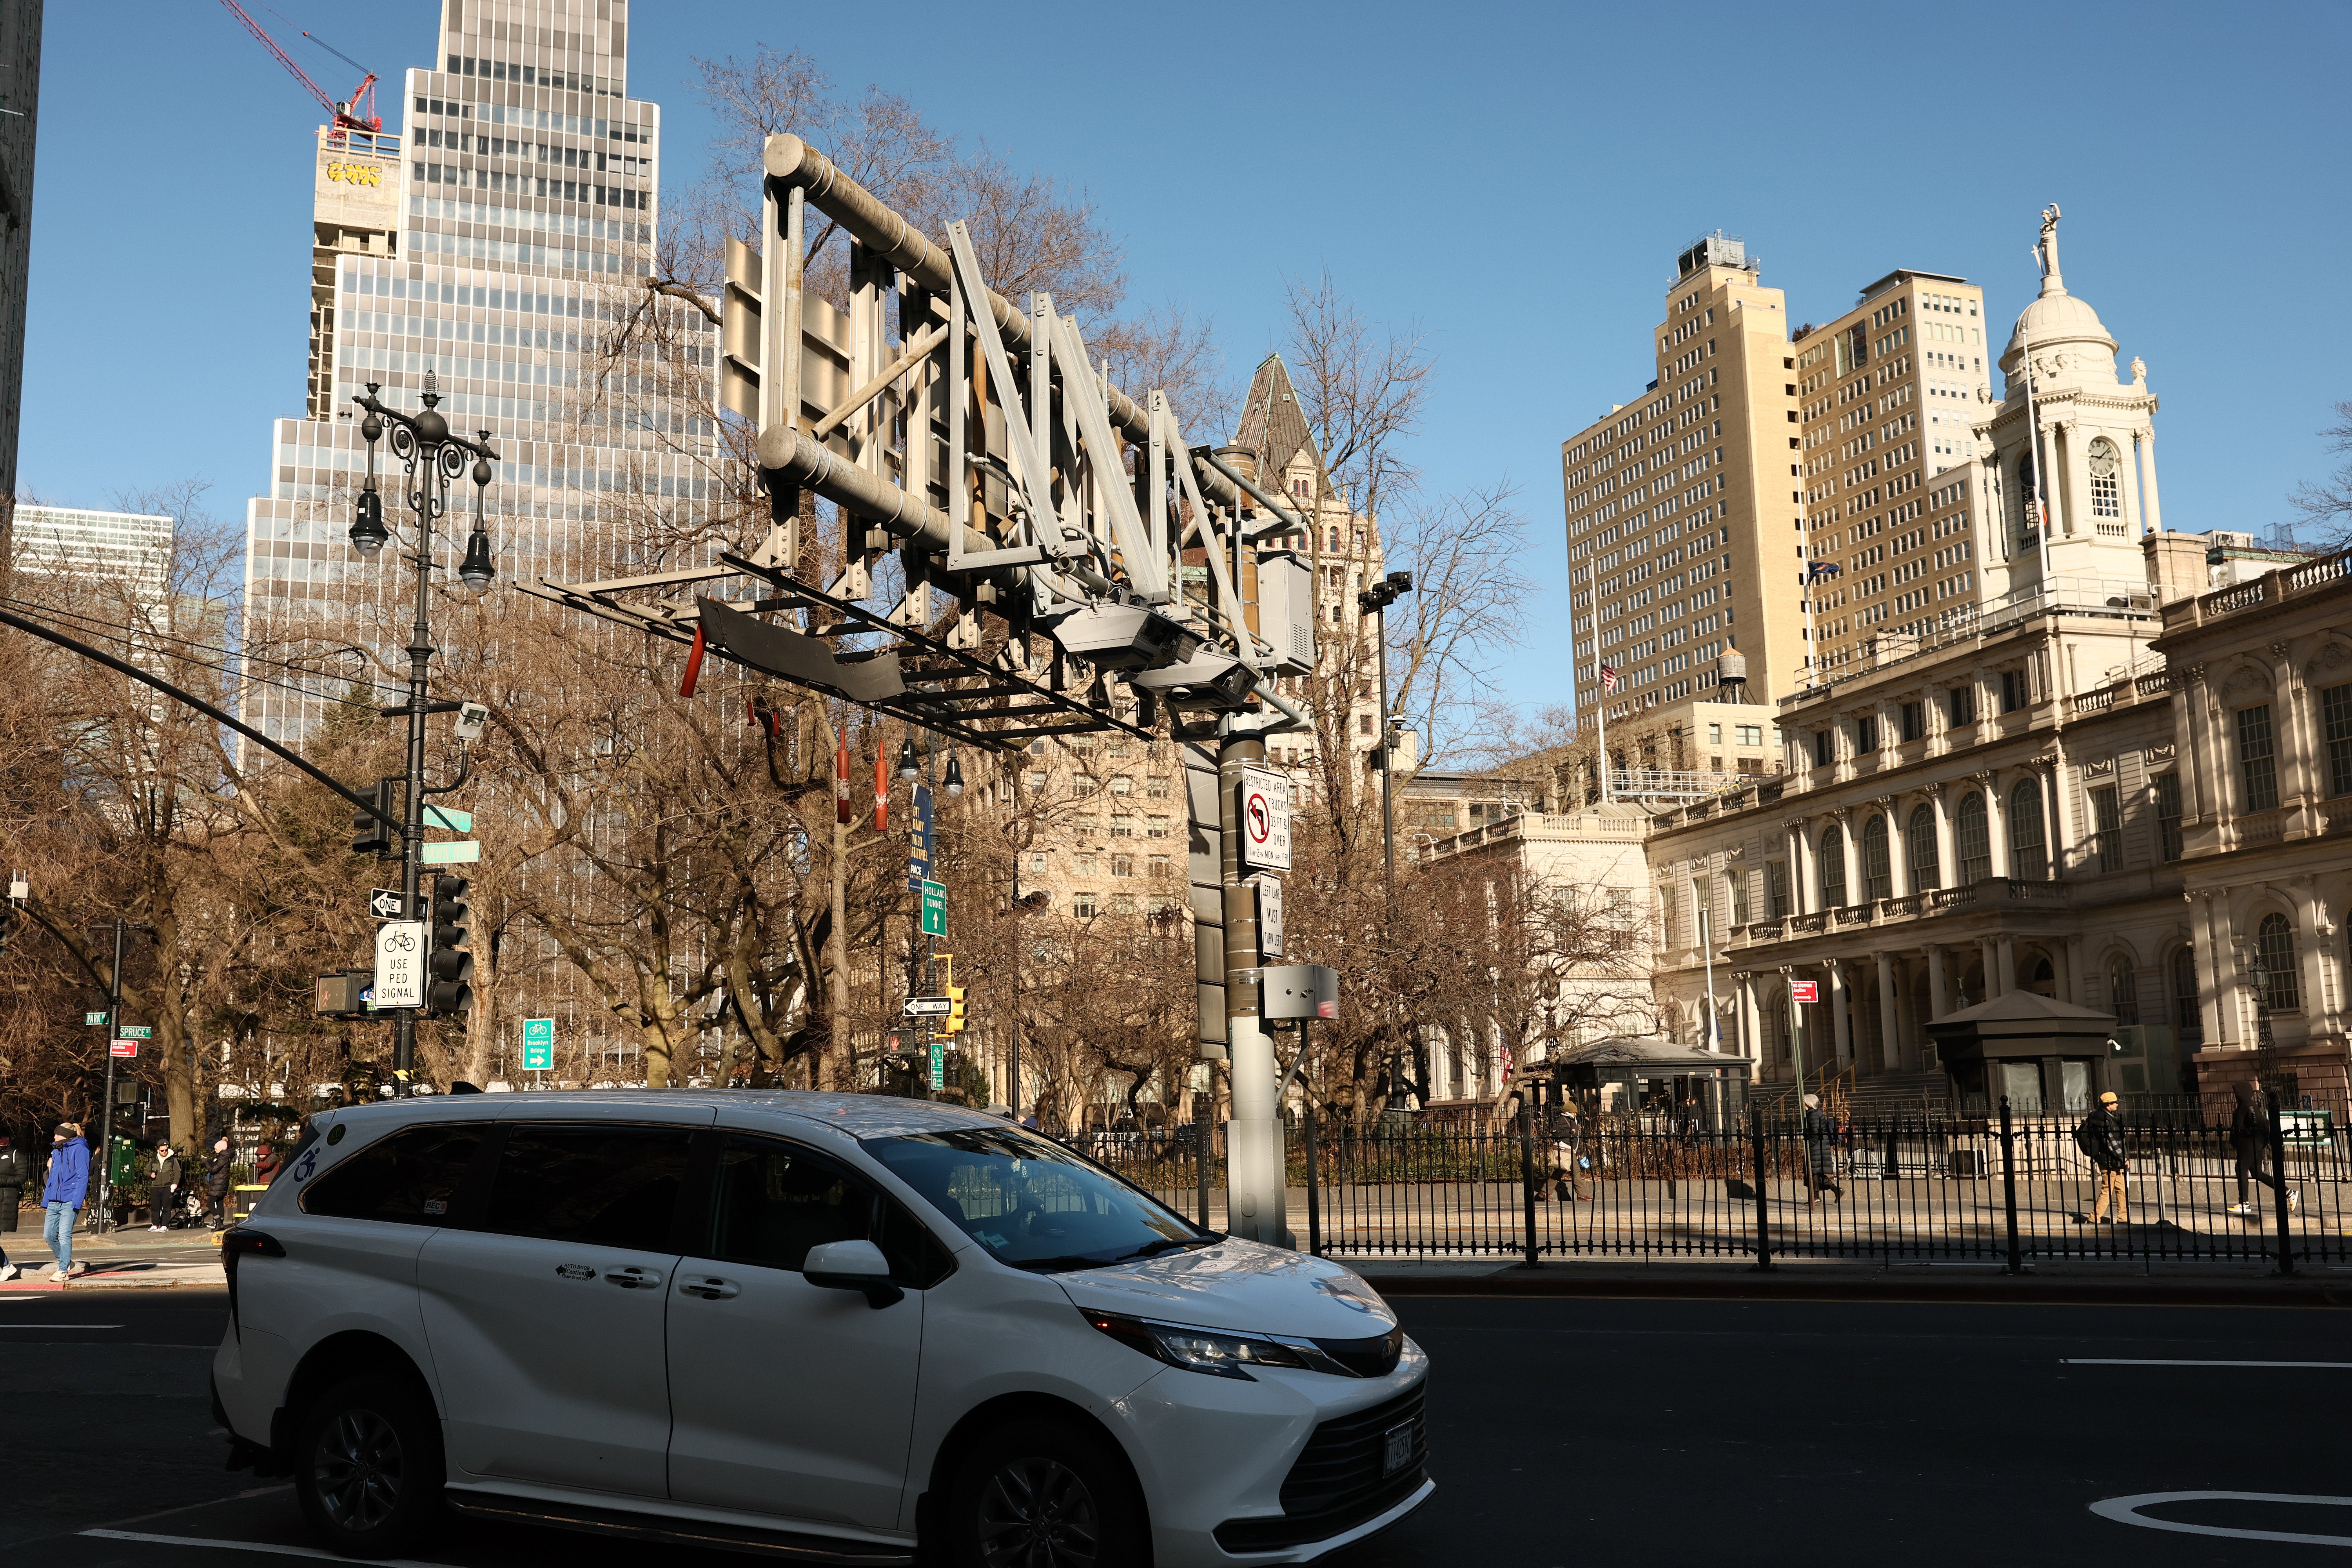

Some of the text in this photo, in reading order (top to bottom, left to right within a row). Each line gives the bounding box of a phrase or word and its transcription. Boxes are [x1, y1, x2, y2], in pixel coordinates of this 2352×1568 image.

[1245, 774, 1286, 795] RESTRICTED AREA
[1269, 798, 1287, 813] TRUCKS
[423, 809, 462, 828] SPRUCE
[913, 818, 924, 832] READY
[1270, 815, 1287, 829] 33 FT &
[1274, 834, 1286, 847] OVER
[423, 844, 475, 860] PARK ROW
[1265, 850, 1274, 860] MON
[910, 864, 922, 876] PACE
[925, 886, 945, 898] HOLLAND
[379, 898, 396, 911] ONE
[926, 898, 944, 910] TUNNEL
[1267, 907, 1278, 924] MUST
[1265, 932, 1273, 945] TURN
[390, 959, 408, 969] USE
[390, 974, 407, 984] PED
[381, 988, 414, 998] SIGNAL
[87, 1014, 100, 1024] PARK
[120, 1027, 145, 1037] SPRUCE
[1387, 1433, 1410, 1465] T114259C
